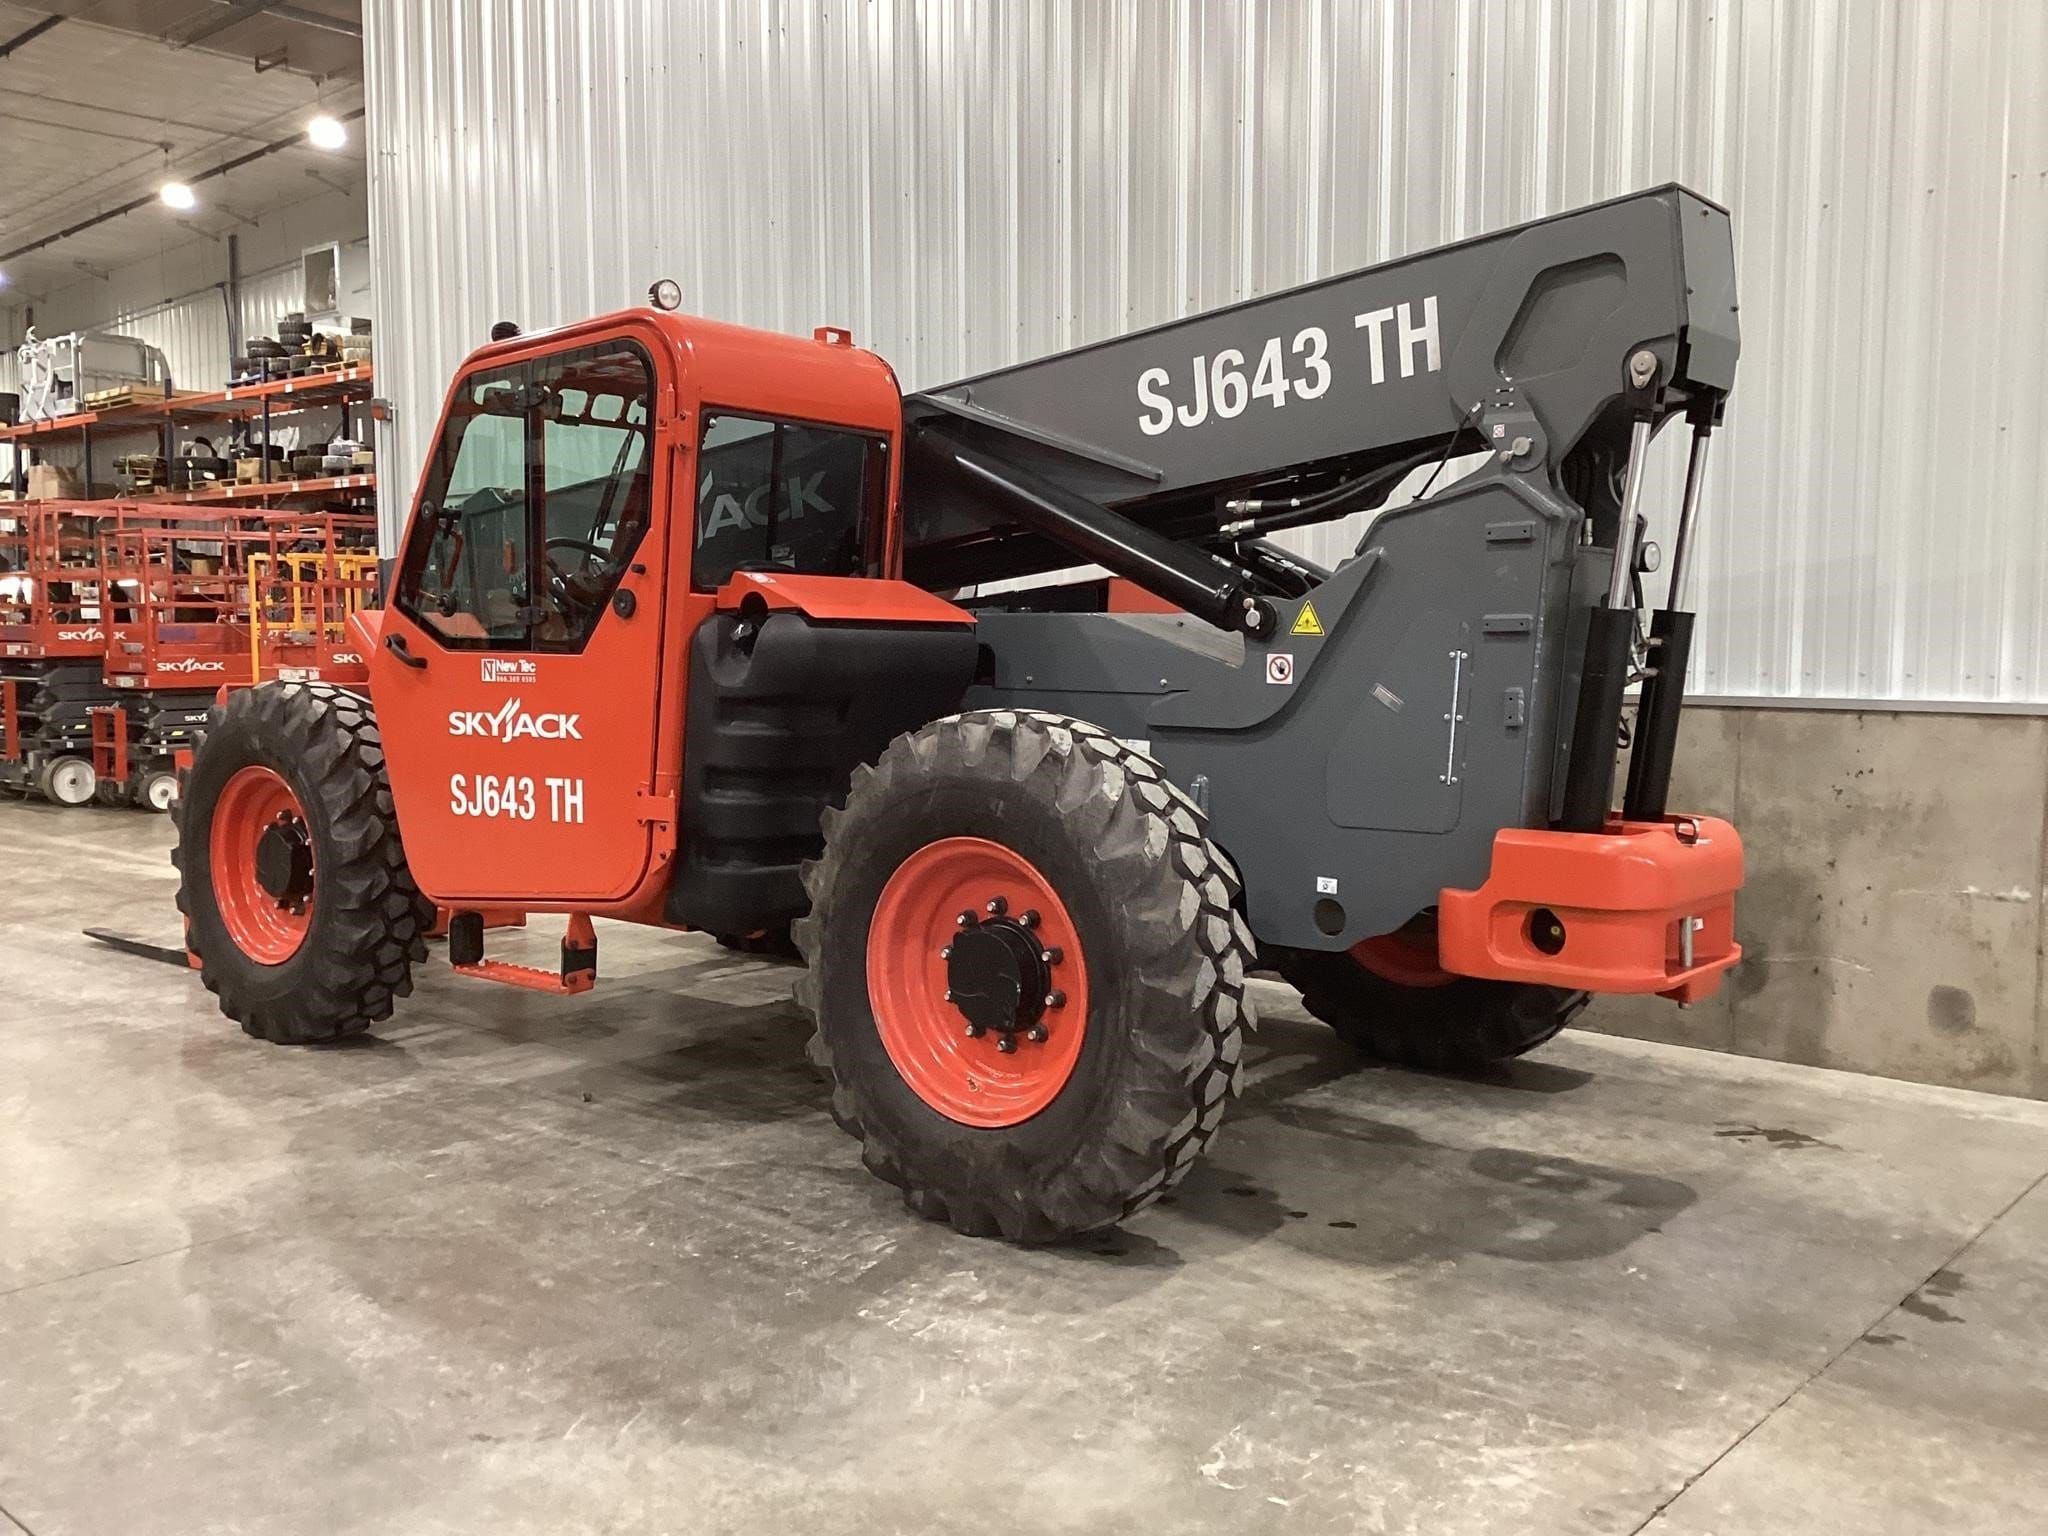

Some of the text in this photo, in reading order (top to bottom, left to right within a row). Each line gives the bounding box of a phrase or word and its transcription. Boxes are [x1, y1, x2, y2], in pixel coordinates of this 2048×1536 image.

[1137, 295, 1441, 436] SJ643 TH
[57, 627, 127, 642] SKYJAK
[156, 657, 225, 673] SKYJACK
[496, 658, 537, 673] New Tec
[448, 697, 583, 743] SKYJACK
[450, 773, 584, 823] SJ643 TH
